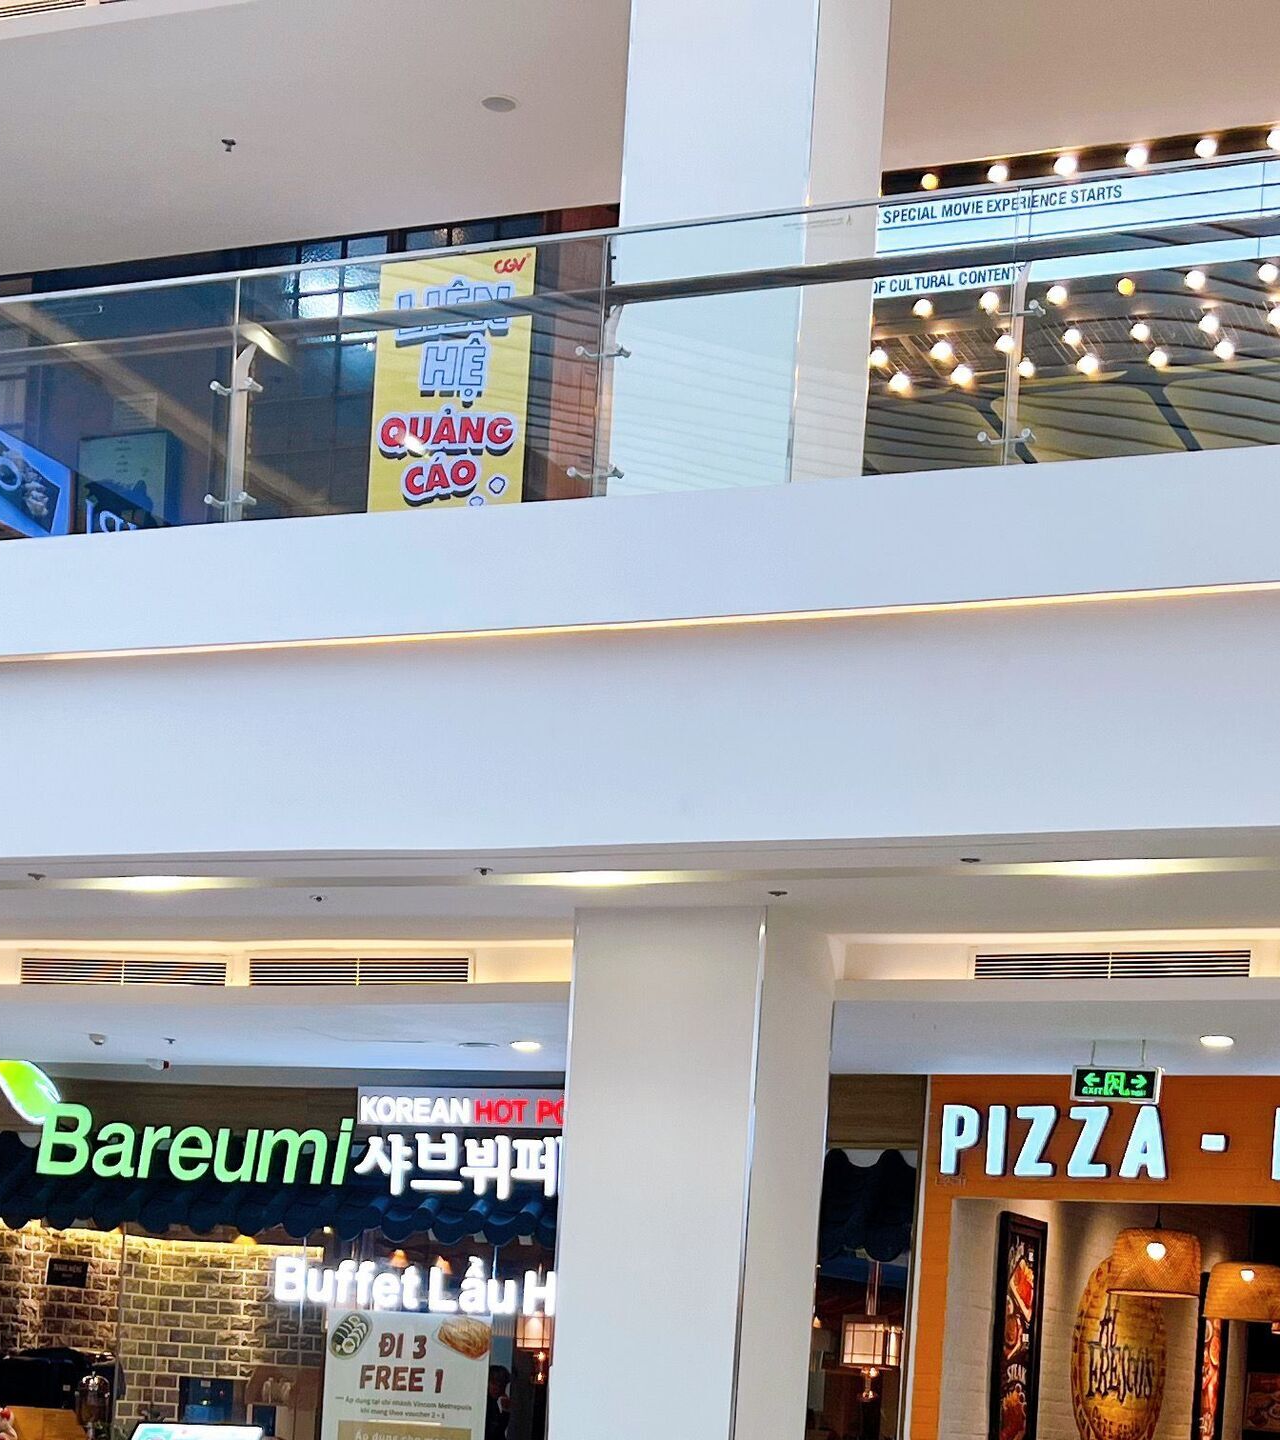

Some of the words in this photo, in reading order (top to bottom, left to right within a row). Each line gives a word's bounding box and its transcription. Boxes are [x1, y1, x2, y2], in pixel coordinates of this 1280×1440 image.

[882, 206, 937, 224] SPECIAL
[941, 200, 983, 217] MOVIE
[986, 191, 1068, 212] EXPERIENCE
[1070, 185, 1122, 204] STARTS
[493, 256, 526, 275] CGV
[889, 274, 954, 292] CULTURAL
[422, 338, 487, 398] HỆ
[380, 408, 514, 451] QUẢNG
[404, 455, 477, 496] CÁO
[360, 1095, 471, 1124] KOREAN
[474, 1099, 528, 1125] HOT
[35, 1102, 356, 1186] Bareumi
[939, 1104, 1168, 1180] PIZZA
[1200, 1132, 1228, 1153] -
[274, 1256, 421, 1311] Buffet
[377, 1332, 405, 1360] ĐI
[412, 1334, 428, 1360] 3
[359, 1364, 426, 1393] FREE
[433, 1368, 445, 1394] 1
[1006, 1364, 1027, 1385] STEAK
